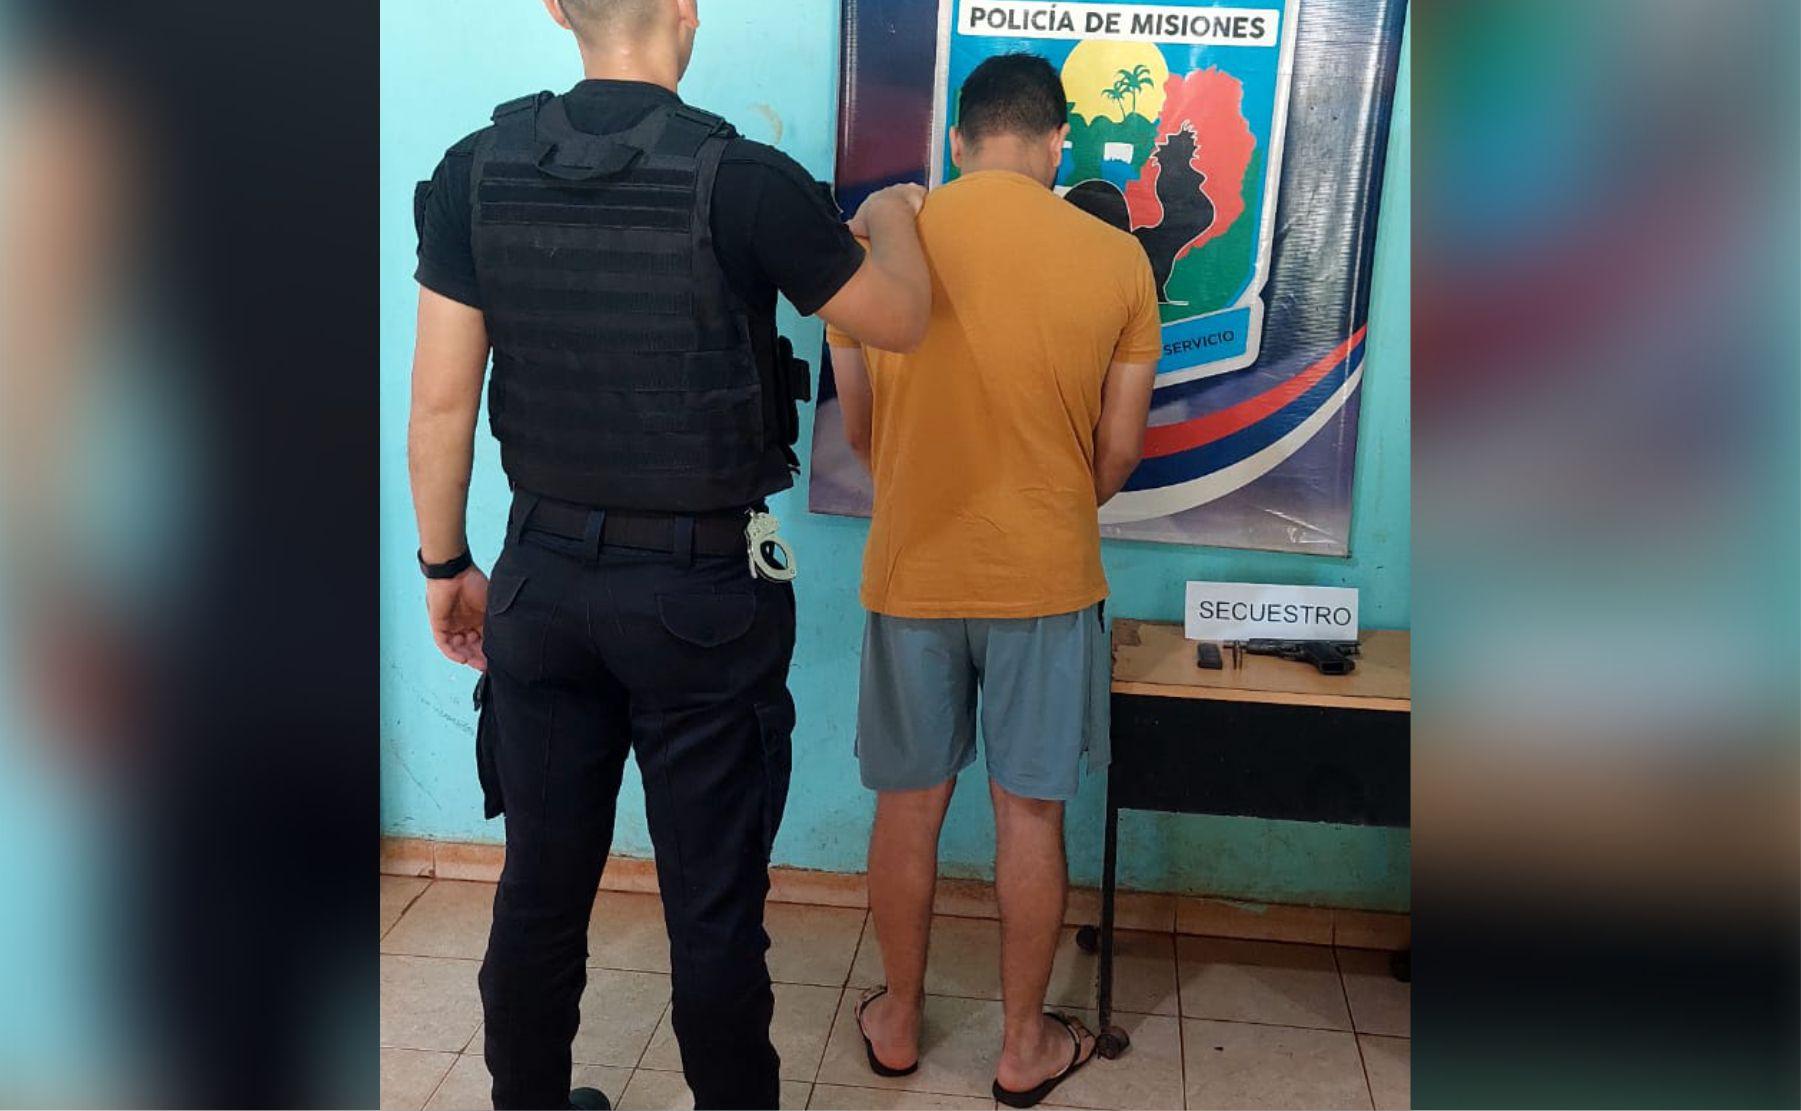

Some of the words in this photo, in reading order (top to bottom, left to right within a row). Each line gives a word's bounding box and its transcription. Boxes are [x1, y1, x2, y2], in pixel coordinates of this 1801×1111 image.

[969, 4, 1075, 32] POLICÍA
[1085, 12, 1119, 33] DE
[1130, 13, 1266, 39] MISIONES
[1163, 330, 1235, 355] SERVICIO
[1199, 600, 1351, 626] SECUESTRO
